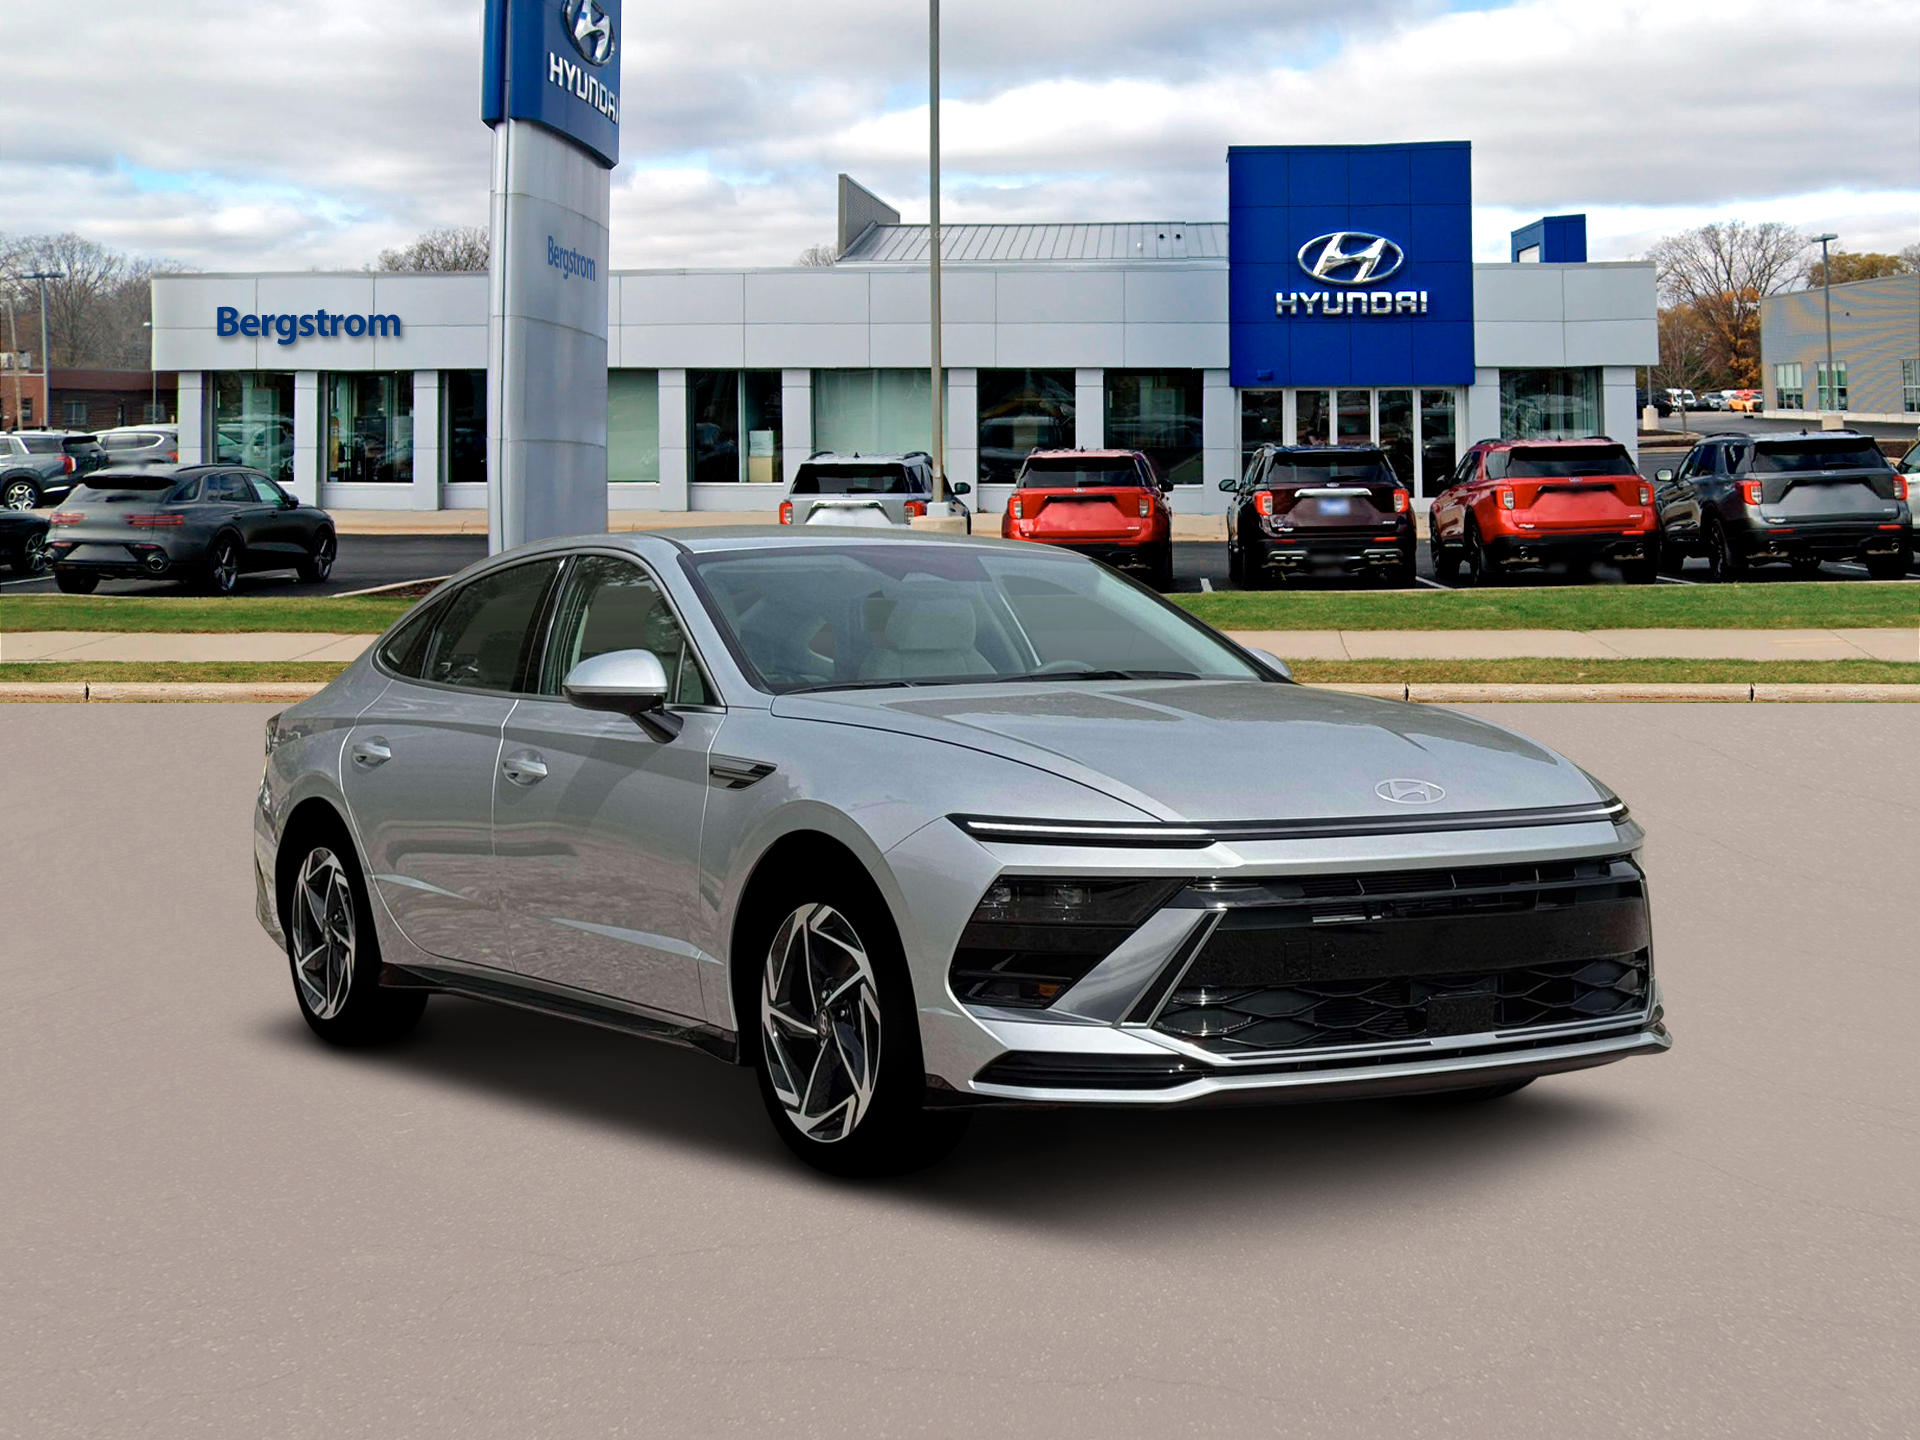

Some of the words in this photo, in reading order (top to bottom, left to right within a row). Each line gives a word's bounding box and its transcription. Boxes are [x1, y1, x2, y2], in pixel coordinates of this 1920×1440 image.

[548, 52, 619, 124] HYUNDAI
[547, 235, 596, 282] Bergstrom
[1275, 291, 1428, 315] HYUNDAI
[216, 306, 401, 346] Bergstrom
